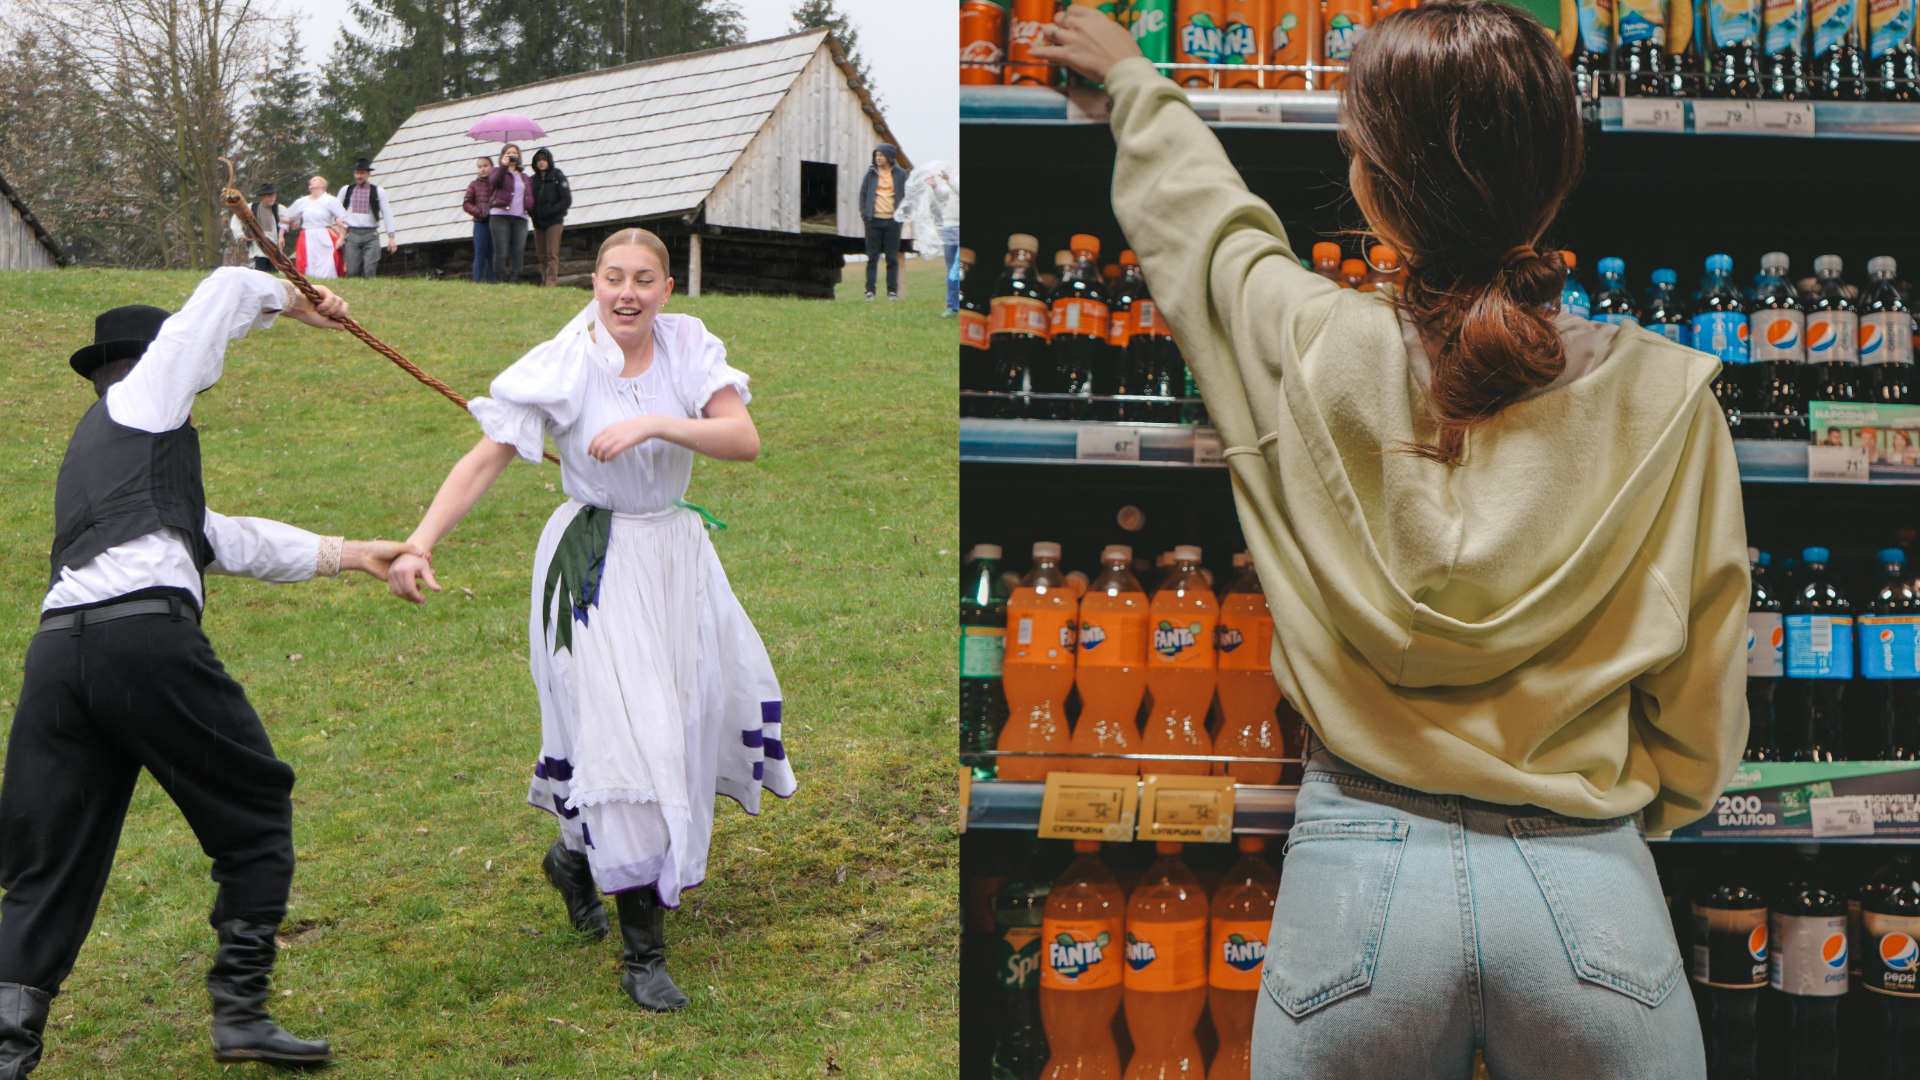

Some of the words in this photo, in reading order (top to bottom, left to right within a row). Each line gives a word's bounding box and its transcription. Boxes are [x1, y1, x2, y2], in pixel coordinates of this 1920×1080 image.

[1180, 24, 1224, 57] FAN
[1725, 109, 1742, 122] 79
[1783, 110, 1802, 124] 73
[1154, 627, 1195, 649] FANTA
[1718, 795, 1762, 815] 200
[1718, 813, 1777, 826] БАЛЛОВ
[1848, 811, 1861, 825] 49
[1049, 942, 1103, 969] FANTA
[1006, 952, 1042, 990] Spr
[1825, 972, 1846, 984] peps
[1884, 971, 1916, 984] pepsi
